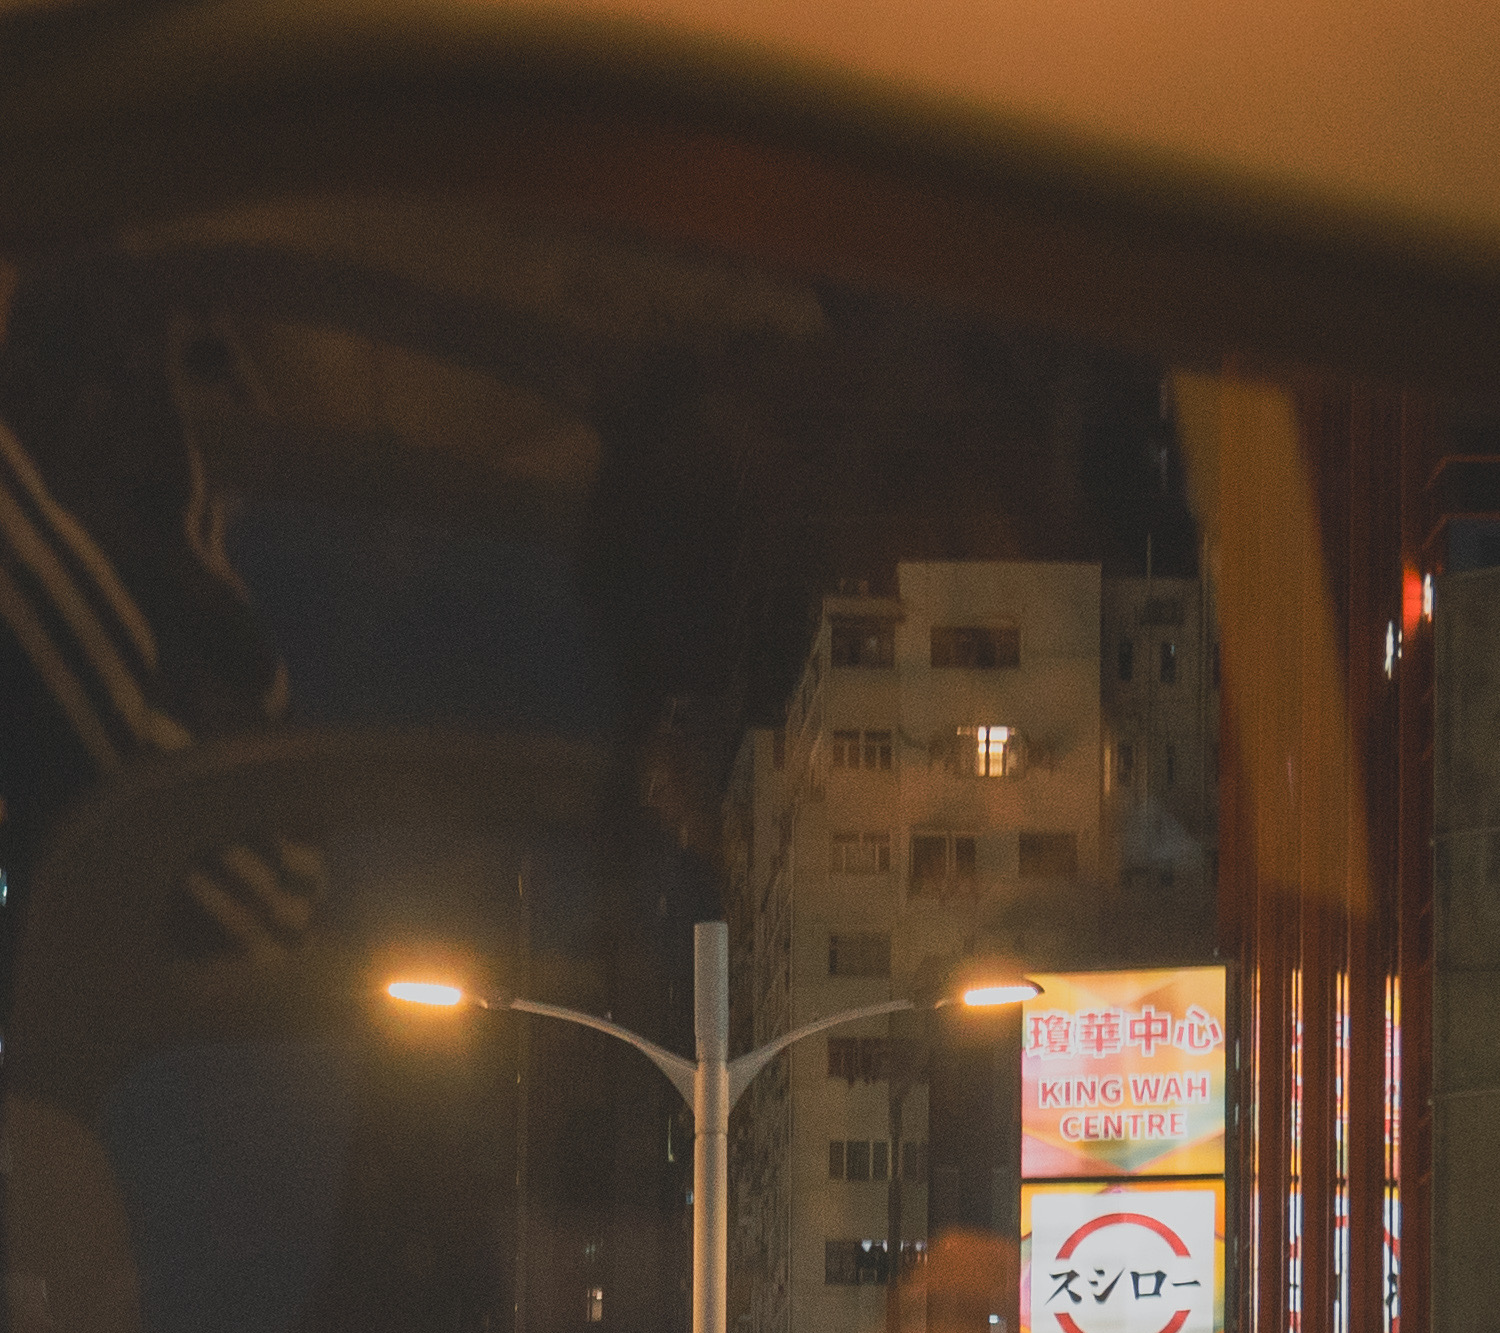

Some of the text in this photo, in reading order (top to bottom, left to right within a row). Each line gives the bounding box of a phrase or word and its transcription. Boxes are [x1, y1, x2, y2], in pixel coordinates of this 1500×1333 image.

[1039, 1073, 1210, 1107] KING WAH
[1060, 1112, 1187, 1140] CENTRE
[1045, 1265, 1202, 1307] スシロー
